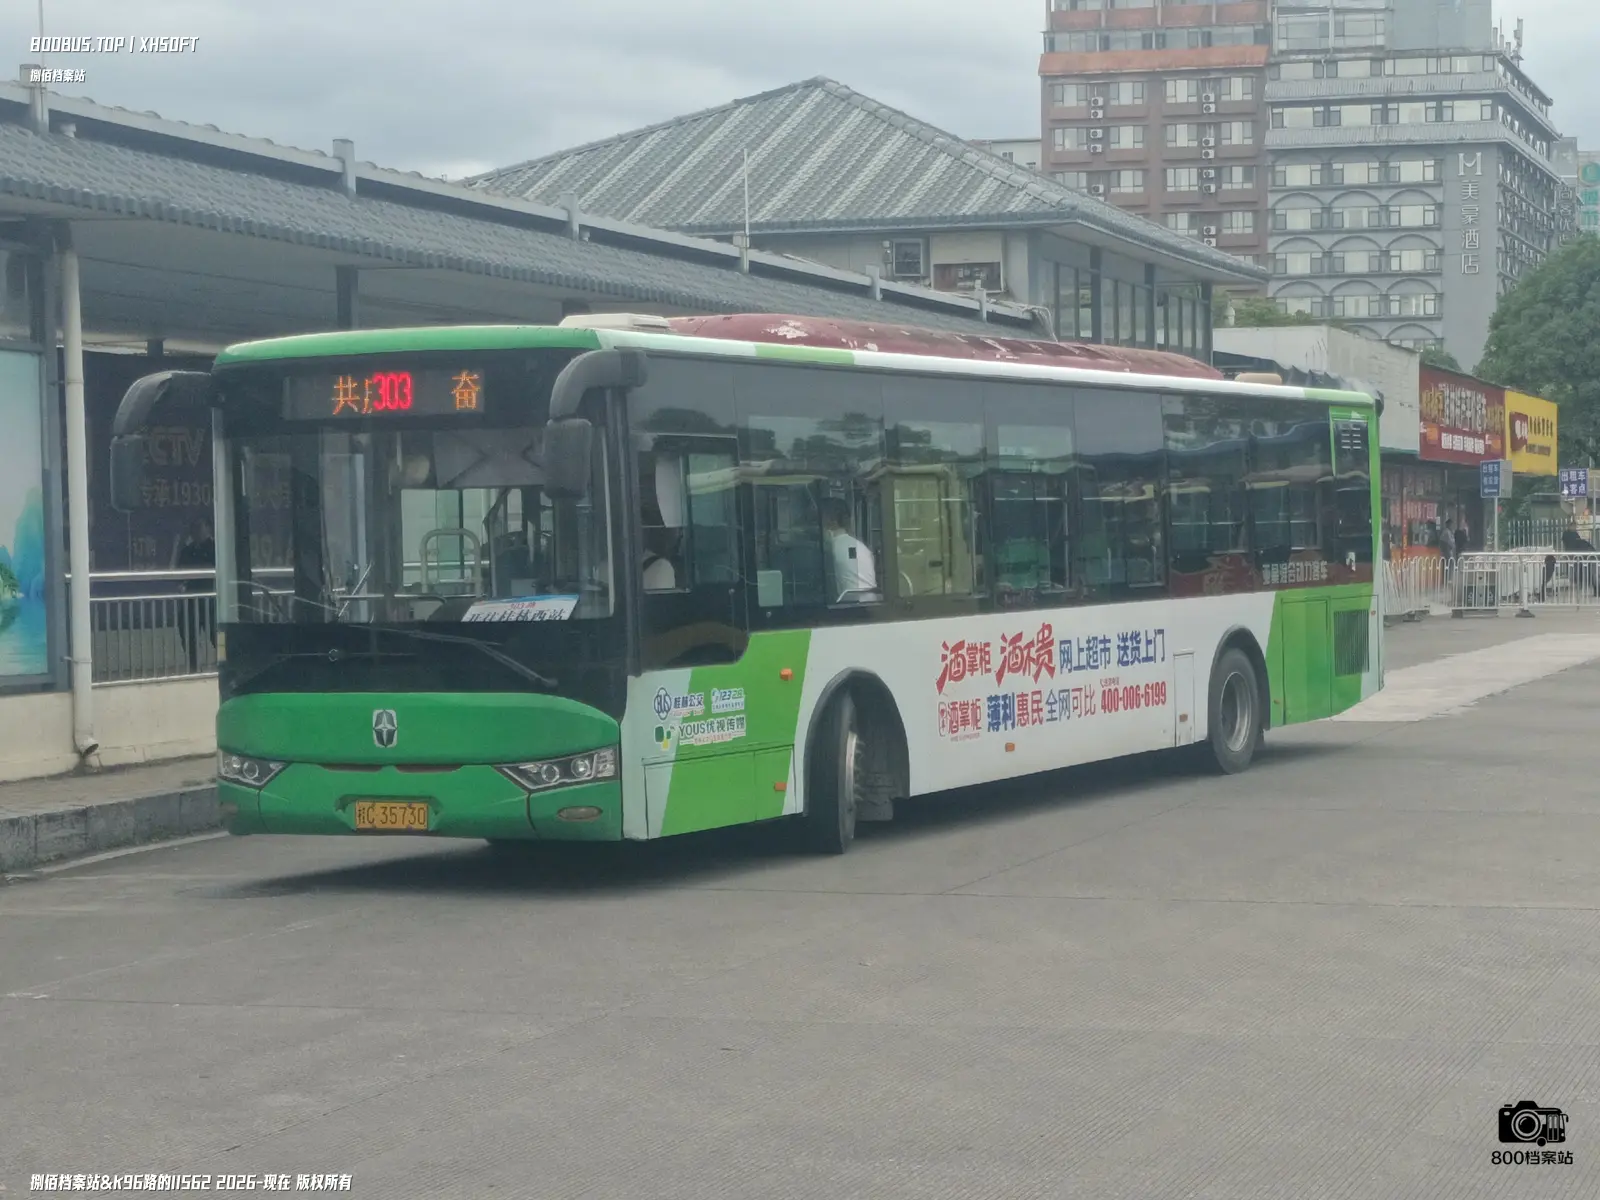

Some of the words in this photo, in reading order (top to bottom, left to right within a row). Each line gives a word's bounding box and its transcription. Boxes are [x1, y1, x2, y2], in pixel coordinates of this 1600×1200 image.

[1458, 152, 1482, 176] M
[372, 371, 413, 411] 303
[451, 370, 480, 410] 奋
[141, 425, 205, 467] CTV
[1561, 470, 1586, 481] 出租车
[936, 639, 992, 695] 酒掌柜
[1059, 634, 1112, 674] 网上超市
[1116, 628, 1166, 667] 送货上门
[1101, 681, 1167, 714] 400-006-6199
[947, 698, 982, 734] 酒掌柜
